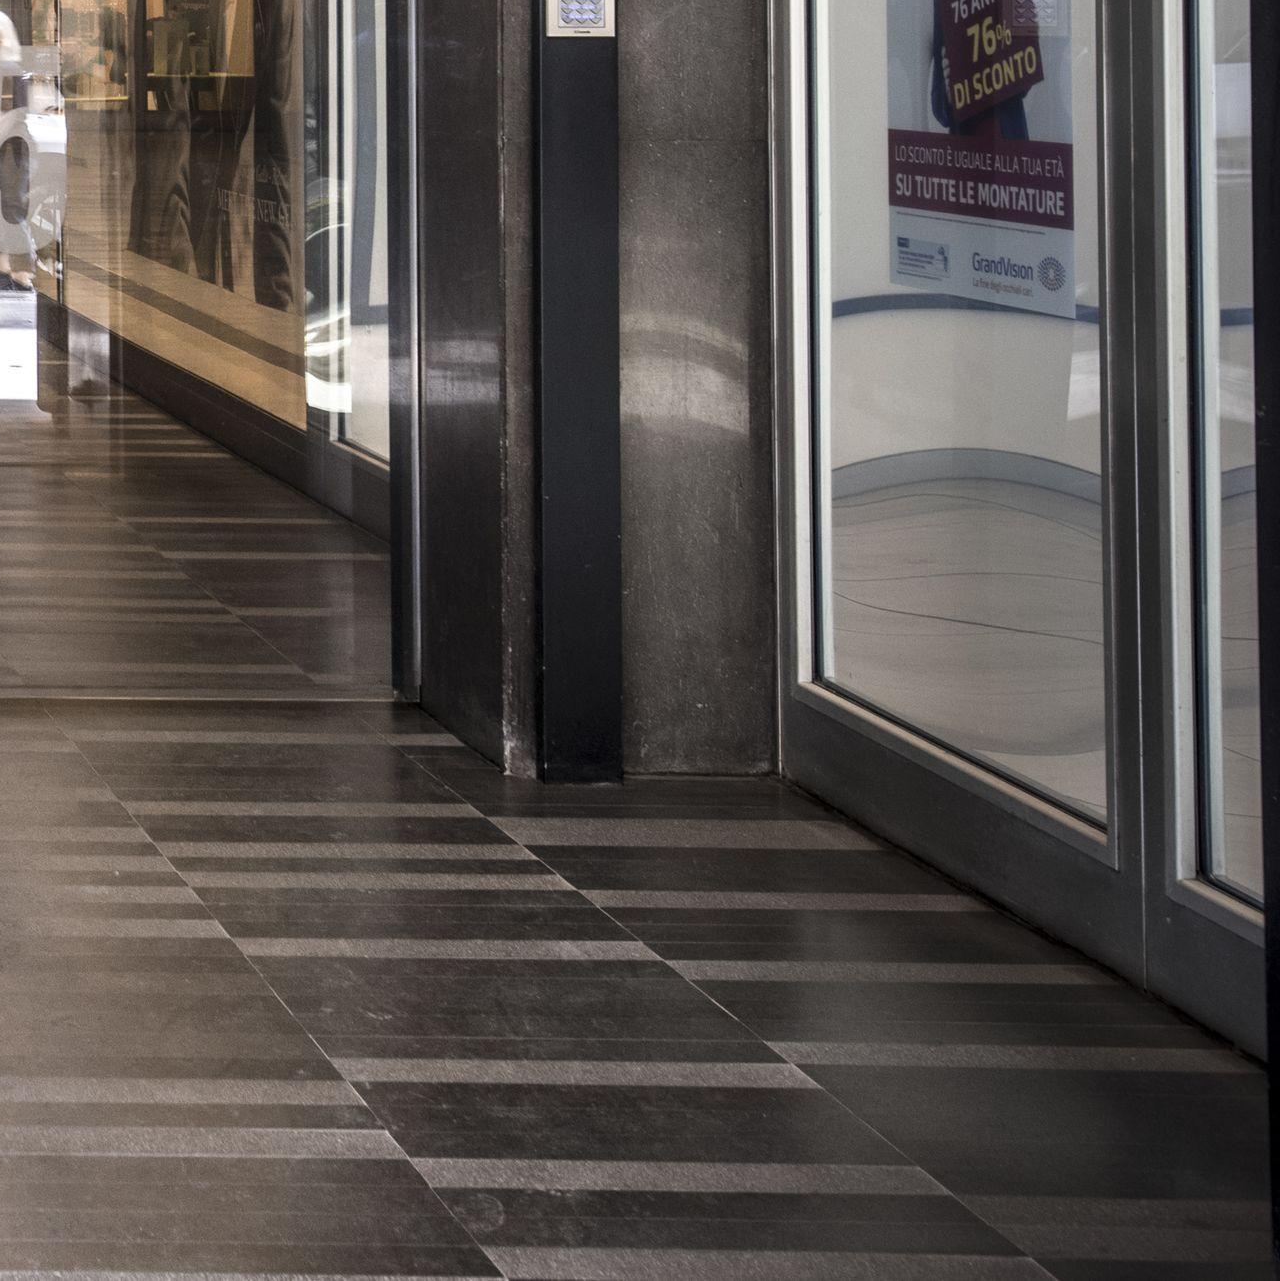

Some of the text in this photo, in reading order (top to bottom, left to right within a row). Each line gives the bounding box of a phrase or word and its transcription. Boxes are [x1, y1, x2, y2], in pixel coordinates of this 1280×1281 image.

[966, 16, 1013, 63] 76%
[953, 45, 1037, 109] DI SCONTO
[895, 145, 1065, 178] LO SCONTO È UGUALE ALLA TUA ETÀ
[895, 172, 1065, 217] SU TUTTE LE MONTATURE
[972, 251, 1034, 282] GrandVision
